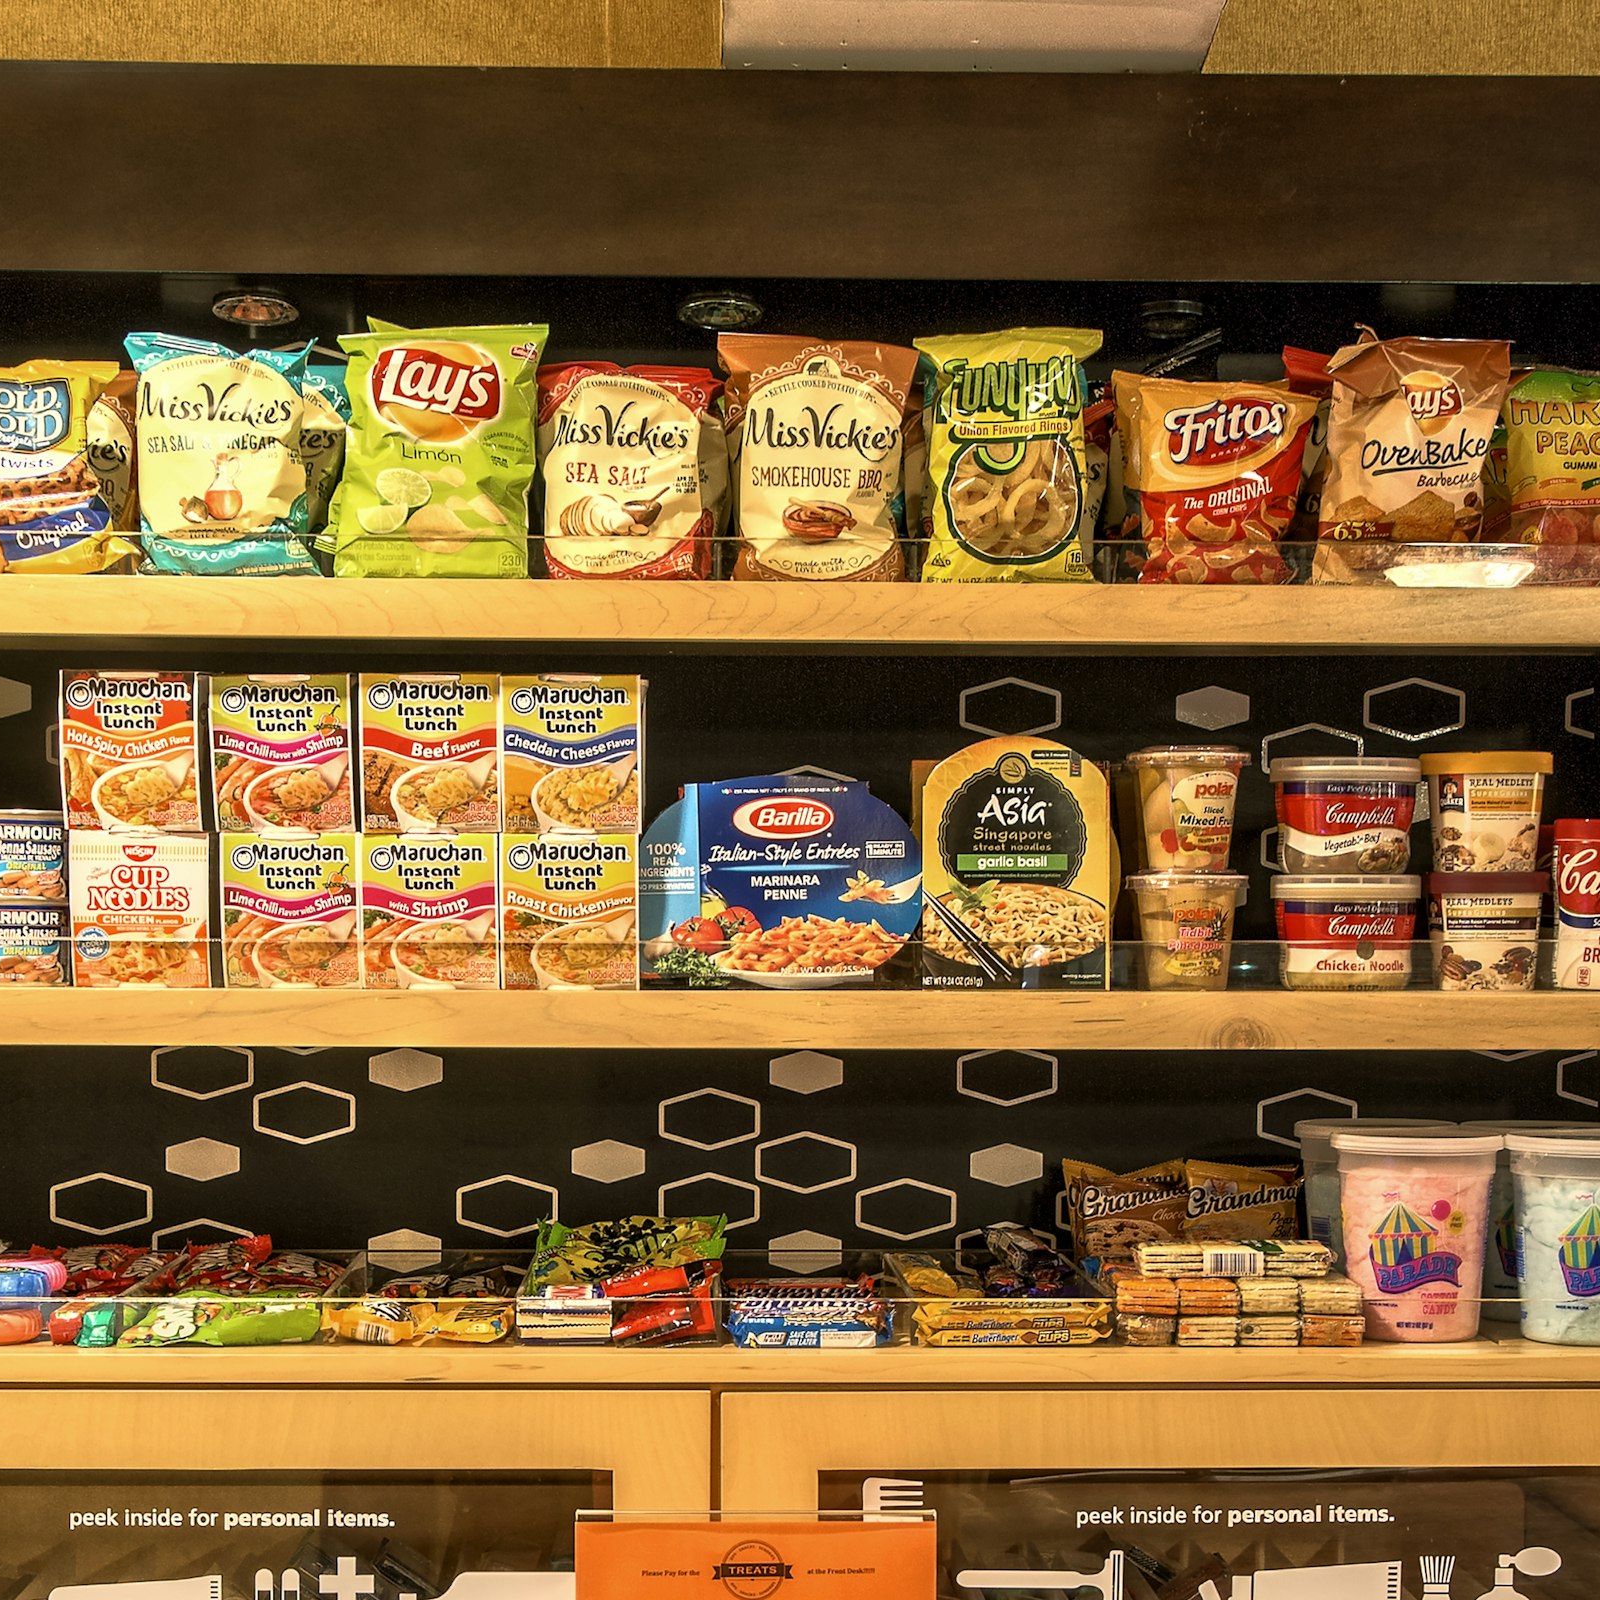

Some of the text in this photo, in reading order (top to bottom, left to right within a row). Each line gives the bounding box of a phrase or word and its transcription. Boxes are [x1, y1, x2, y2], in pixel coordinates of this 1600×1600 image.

[379, 349, 495, 414] Lay's
[768, 380, 854, 397] KETTLE COOKED POTATO
[596, 401, 689, 460] Vickie's
[746, 404, 900, 462] Miss Vickie's
[993, 420, 1068, 436] Flavored Rings
[1163, 401, 1287, 463] Fritos
[401, 443, 463, 464] Limón
[1210, 445, 1247, 459] BRAND
[1362, 428, 1489, 469] OvenBake
[1, 457, 54, 468] twists
[1563, 461, 1597, 469] GUMMI
[565, 462, 649, 486] SEA SALT
[752, 466, 882, 492] SMOKEHOUSE BBQ
[1417, 472, 1480, 488] Barbecue
[1184, 478, 1272, 510] The ORIGINAL
[1211, 507, 1229, 516] CORN
[16, 511, 89, 549] Original
[501, 555, 521, 566] 230
[89, 678, 187, 699] Maruchan
[242, 685, 337, 704] Maruchan
[532, 686, 626, 705] Maruchan
[95, 701, 162, 715] Instant
[104, 716, 155, 729] Lunch
[125, 734, 191, 757] Chicken Flavor
[220, 735, 343, 757] Lime Chili Shrimp
[412, 739, 480, 758] Beef Flavor
[506, 734, 605, 760] Cheddar Cheese
[995, 787, 1035, 796] SIMPLY
[1469, 777, 1534, 789] REAL MEDLEYS
[1203, 805, 1224, 816] Sliced
[1439, 798, 1464, 806] QUAKER
[620, 814, 637, 822] Soup
[756, 808, 825, 831] Barilla
[977, 795, 1046, 827] Asia
[1325, 803, 1395, 826] Campbell's
[1180, 814, 1214, 827] Mixed
[973, 827, 1052, 842] Singapore
[124, 847, 154, 856] NISSIN
[645, 843, 686, 856] 100%
[709, 843, 860, 866] Italian-Style Entrées
[973, 843, 1051, 852] street noodles
[652, 856, 679, 867] REAL
[977, 855, 1047, 871] garlic basil
[112, 866, 169, 888] CUP
[751, 875, 820, 887] MARINARA
[88, 887, 189, 911] NOODLES
[764, 888, 808, 900] PENNE
[389, 898, 468, 917] with Shrimp
[507, 892, 633, 917] Roast Chicken Flavor
[102, 915, 154, 923] CHICKEN
[1316, 959, 1404, 973] Chicken Noodle
[1377, 1257, 1460, 1289] PARADE
[1422, 1304, 1457, 1316] CANDY
[972, 1330, 1069, 1344] Butterfinger CUPS
[69, 1507, 395, 1530] peek inside for personal items.
[1076, 1504, 1395, 1528] peek inside for personal items.
[728, 1566, 777, 1574] TREATS
